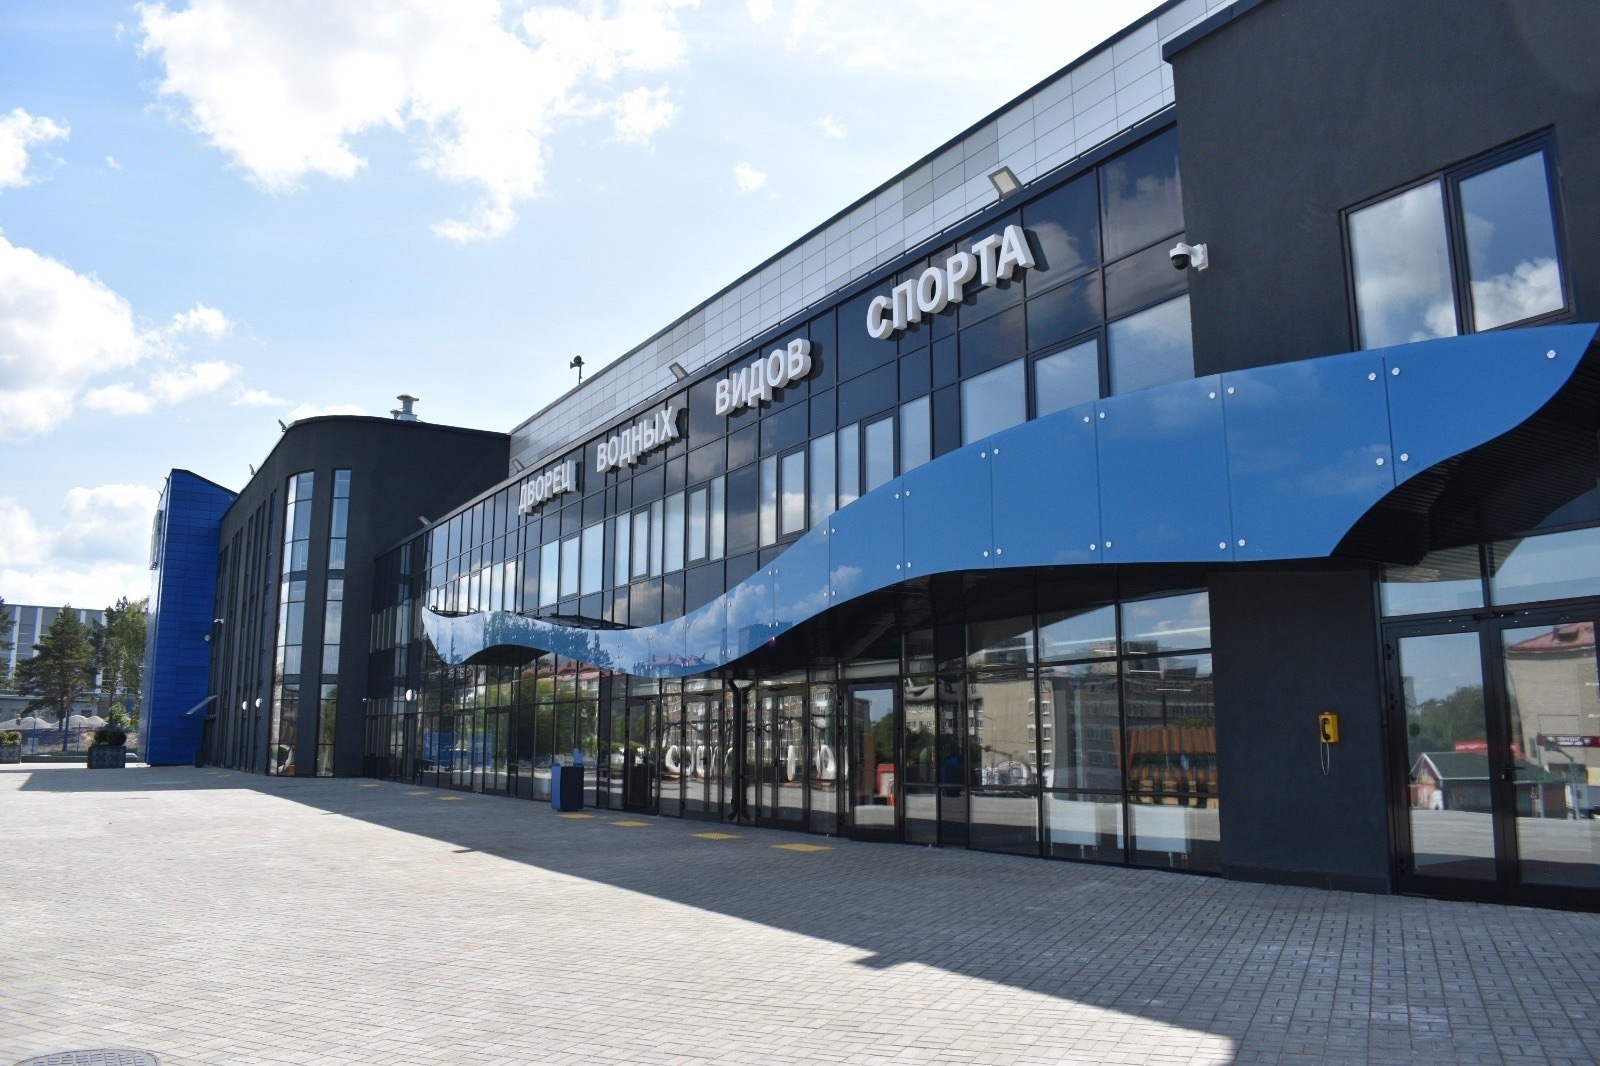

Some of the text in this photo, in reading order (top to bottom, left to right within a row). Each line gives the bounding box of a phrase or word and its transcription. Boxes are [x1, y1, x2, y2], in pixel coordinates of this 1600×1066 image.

[519, 224, 1035, 515] ДВОРЕЦ ВОДНЫХ ВИДОВ СПОРТА
